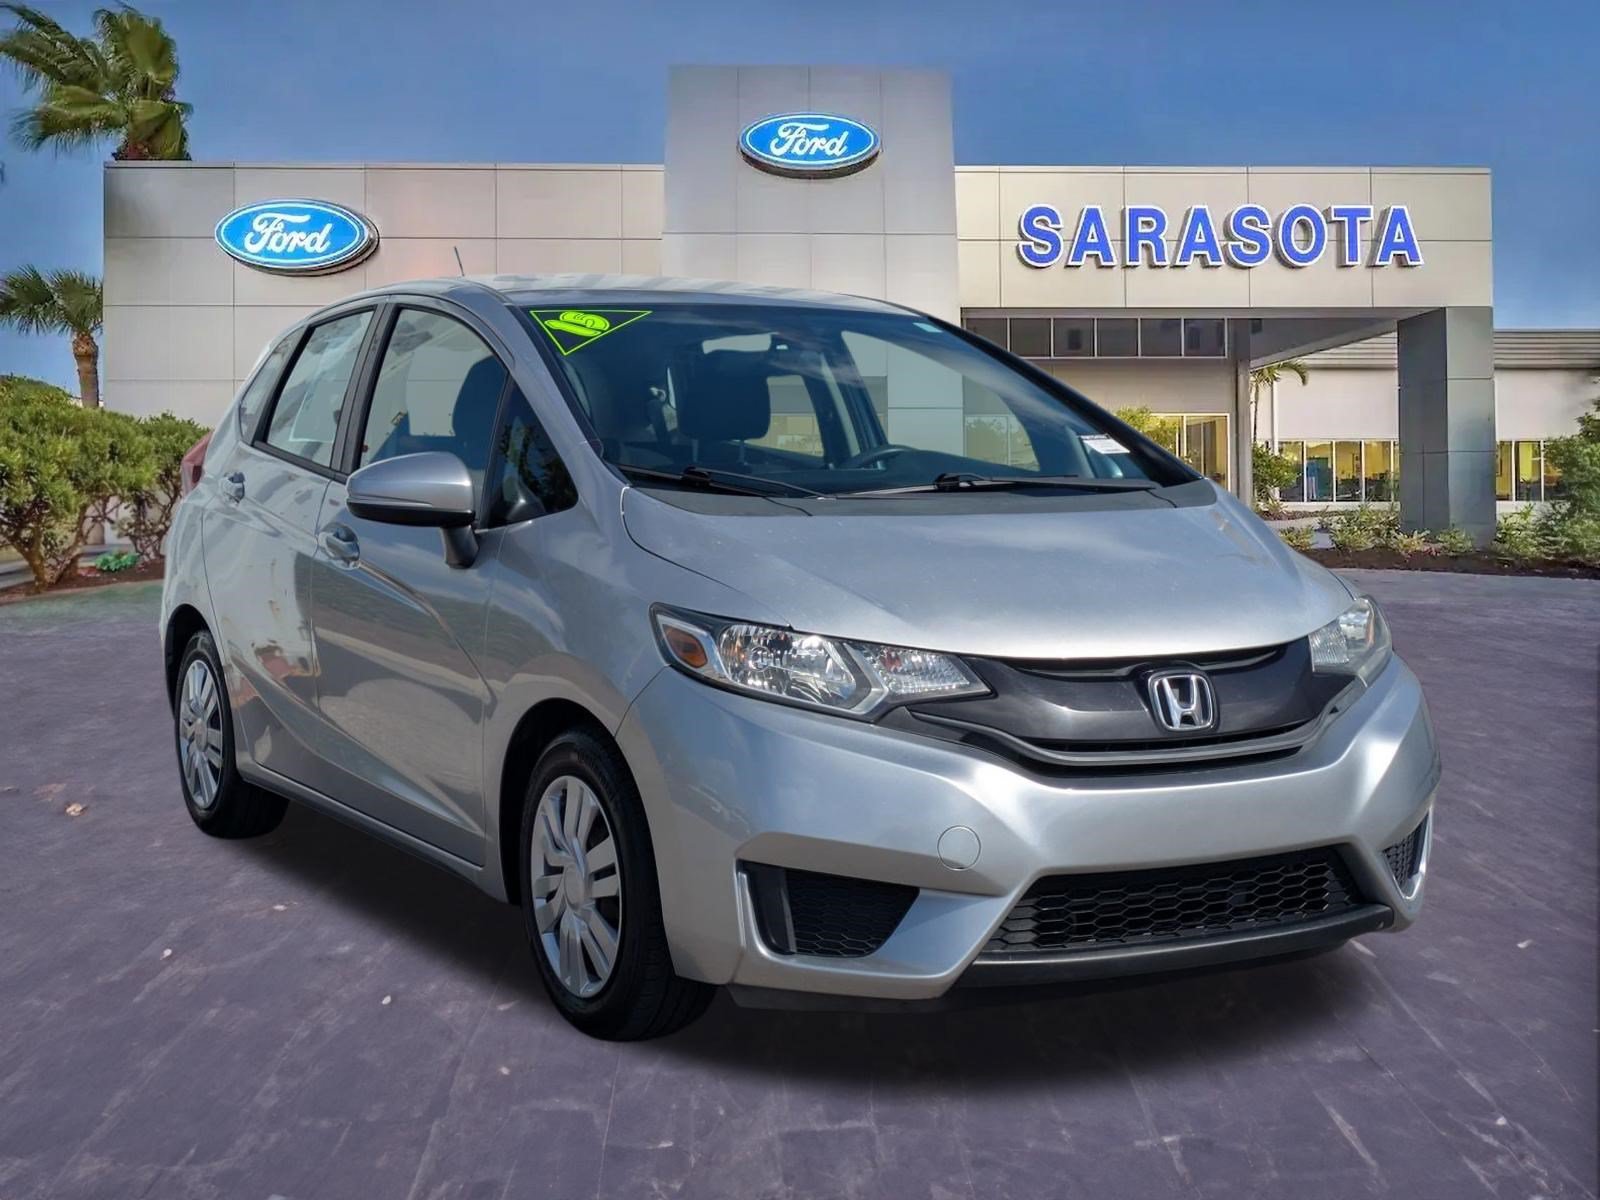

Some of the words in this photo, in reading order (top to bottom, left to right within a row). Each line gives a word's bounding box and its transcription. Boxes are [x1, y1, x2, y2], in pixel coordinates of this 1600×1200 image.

[770, 122, 849, 156] Ford
[244, 212, 333, 254] Ford
[1018, 203, 1424, 268] SARASOTA
